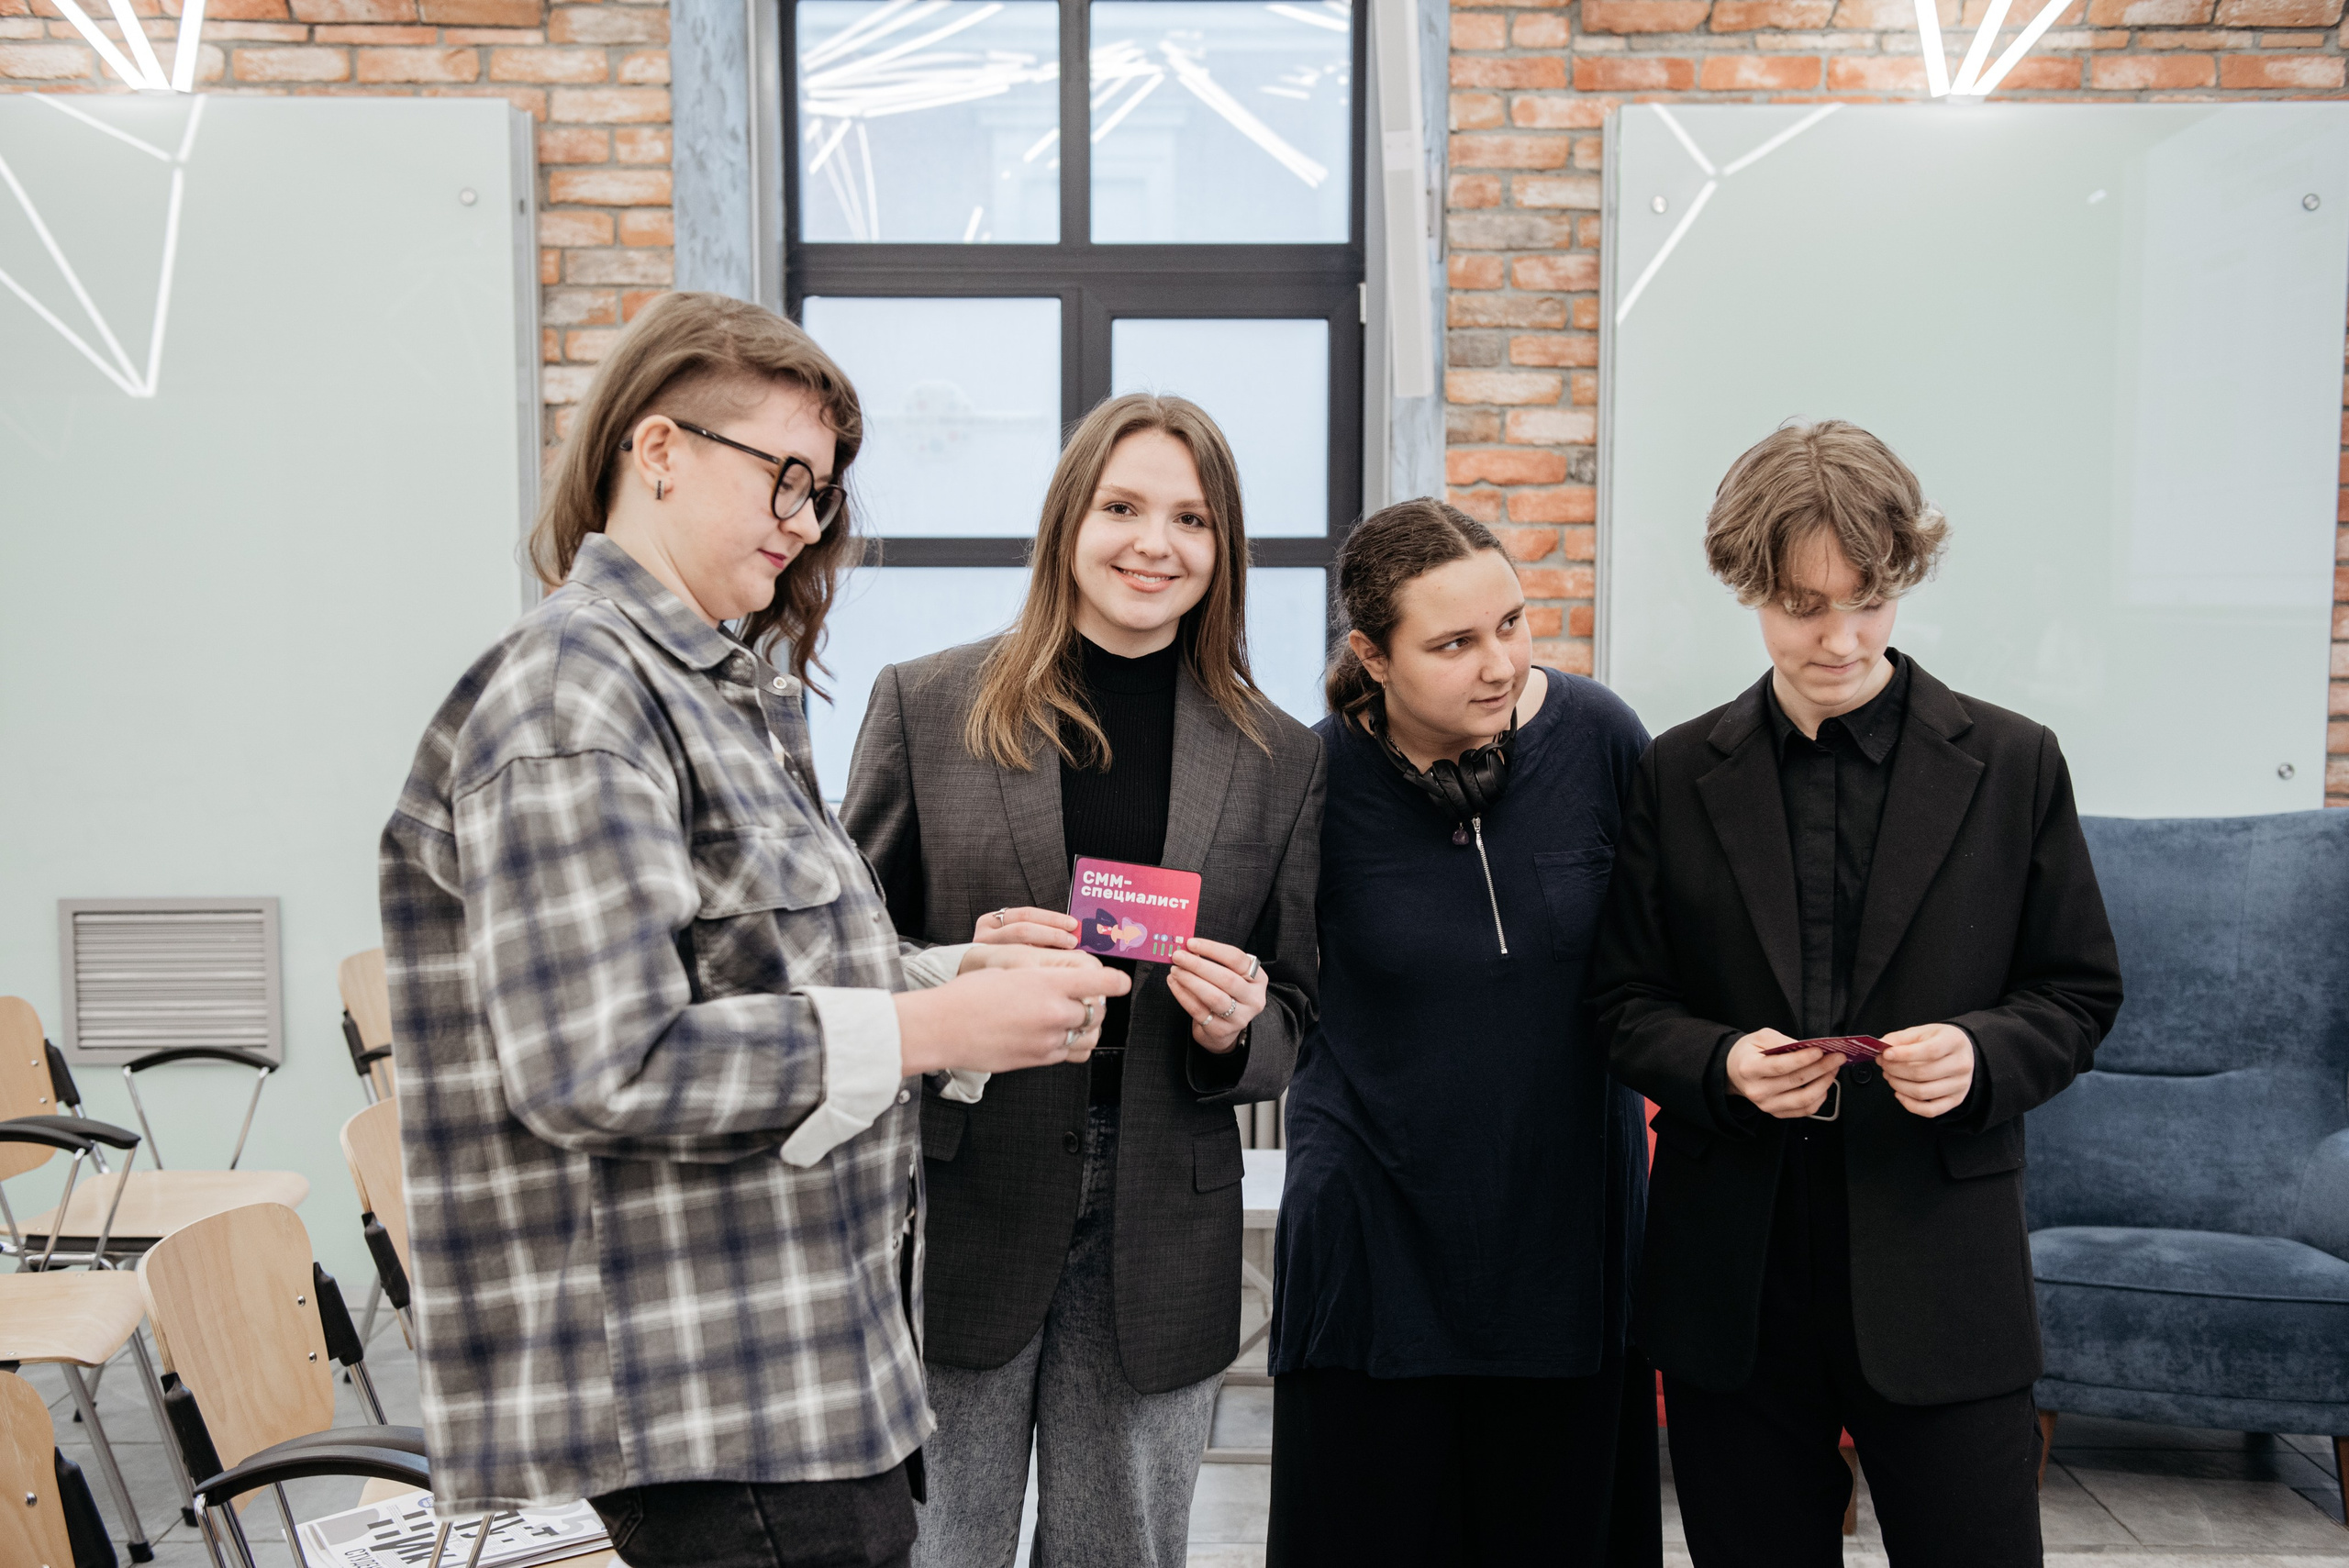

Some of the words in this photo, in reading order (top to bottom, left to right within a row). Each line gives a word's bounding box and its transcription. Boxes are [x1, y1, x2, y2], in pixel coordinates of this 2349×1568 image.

[1083, 871, 1132, 888] СММ-
[1081, 885, 1189, 909] специалист
[344, 1548, 383, 1568] СТУДЕ
